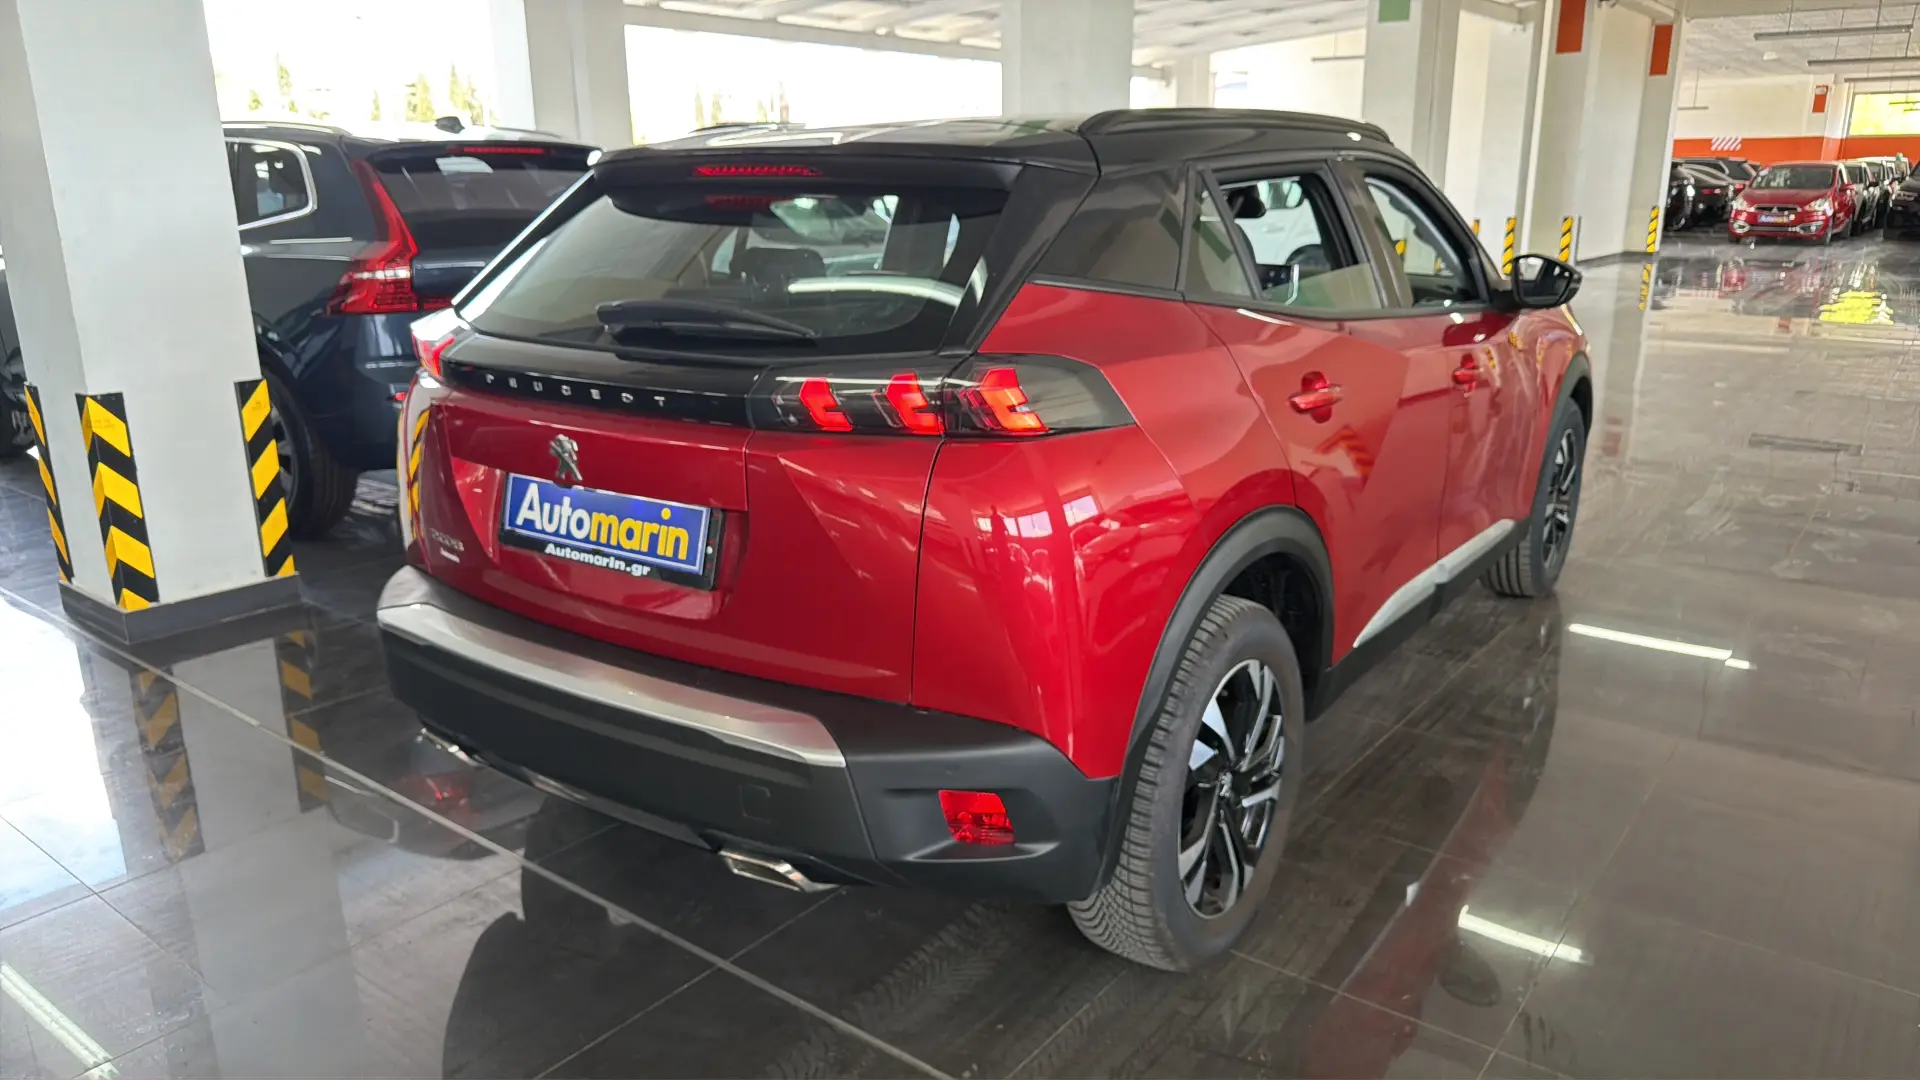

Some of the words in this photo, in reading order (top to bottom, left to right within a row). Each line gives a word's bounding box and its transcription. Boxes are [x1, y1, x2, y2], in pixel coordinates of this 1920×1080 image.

[485, 373, 666, 407] PEUGEOT
[515, 483, 689, 560] Automarin
[544, 543, 651, 577] Automarin.gr
